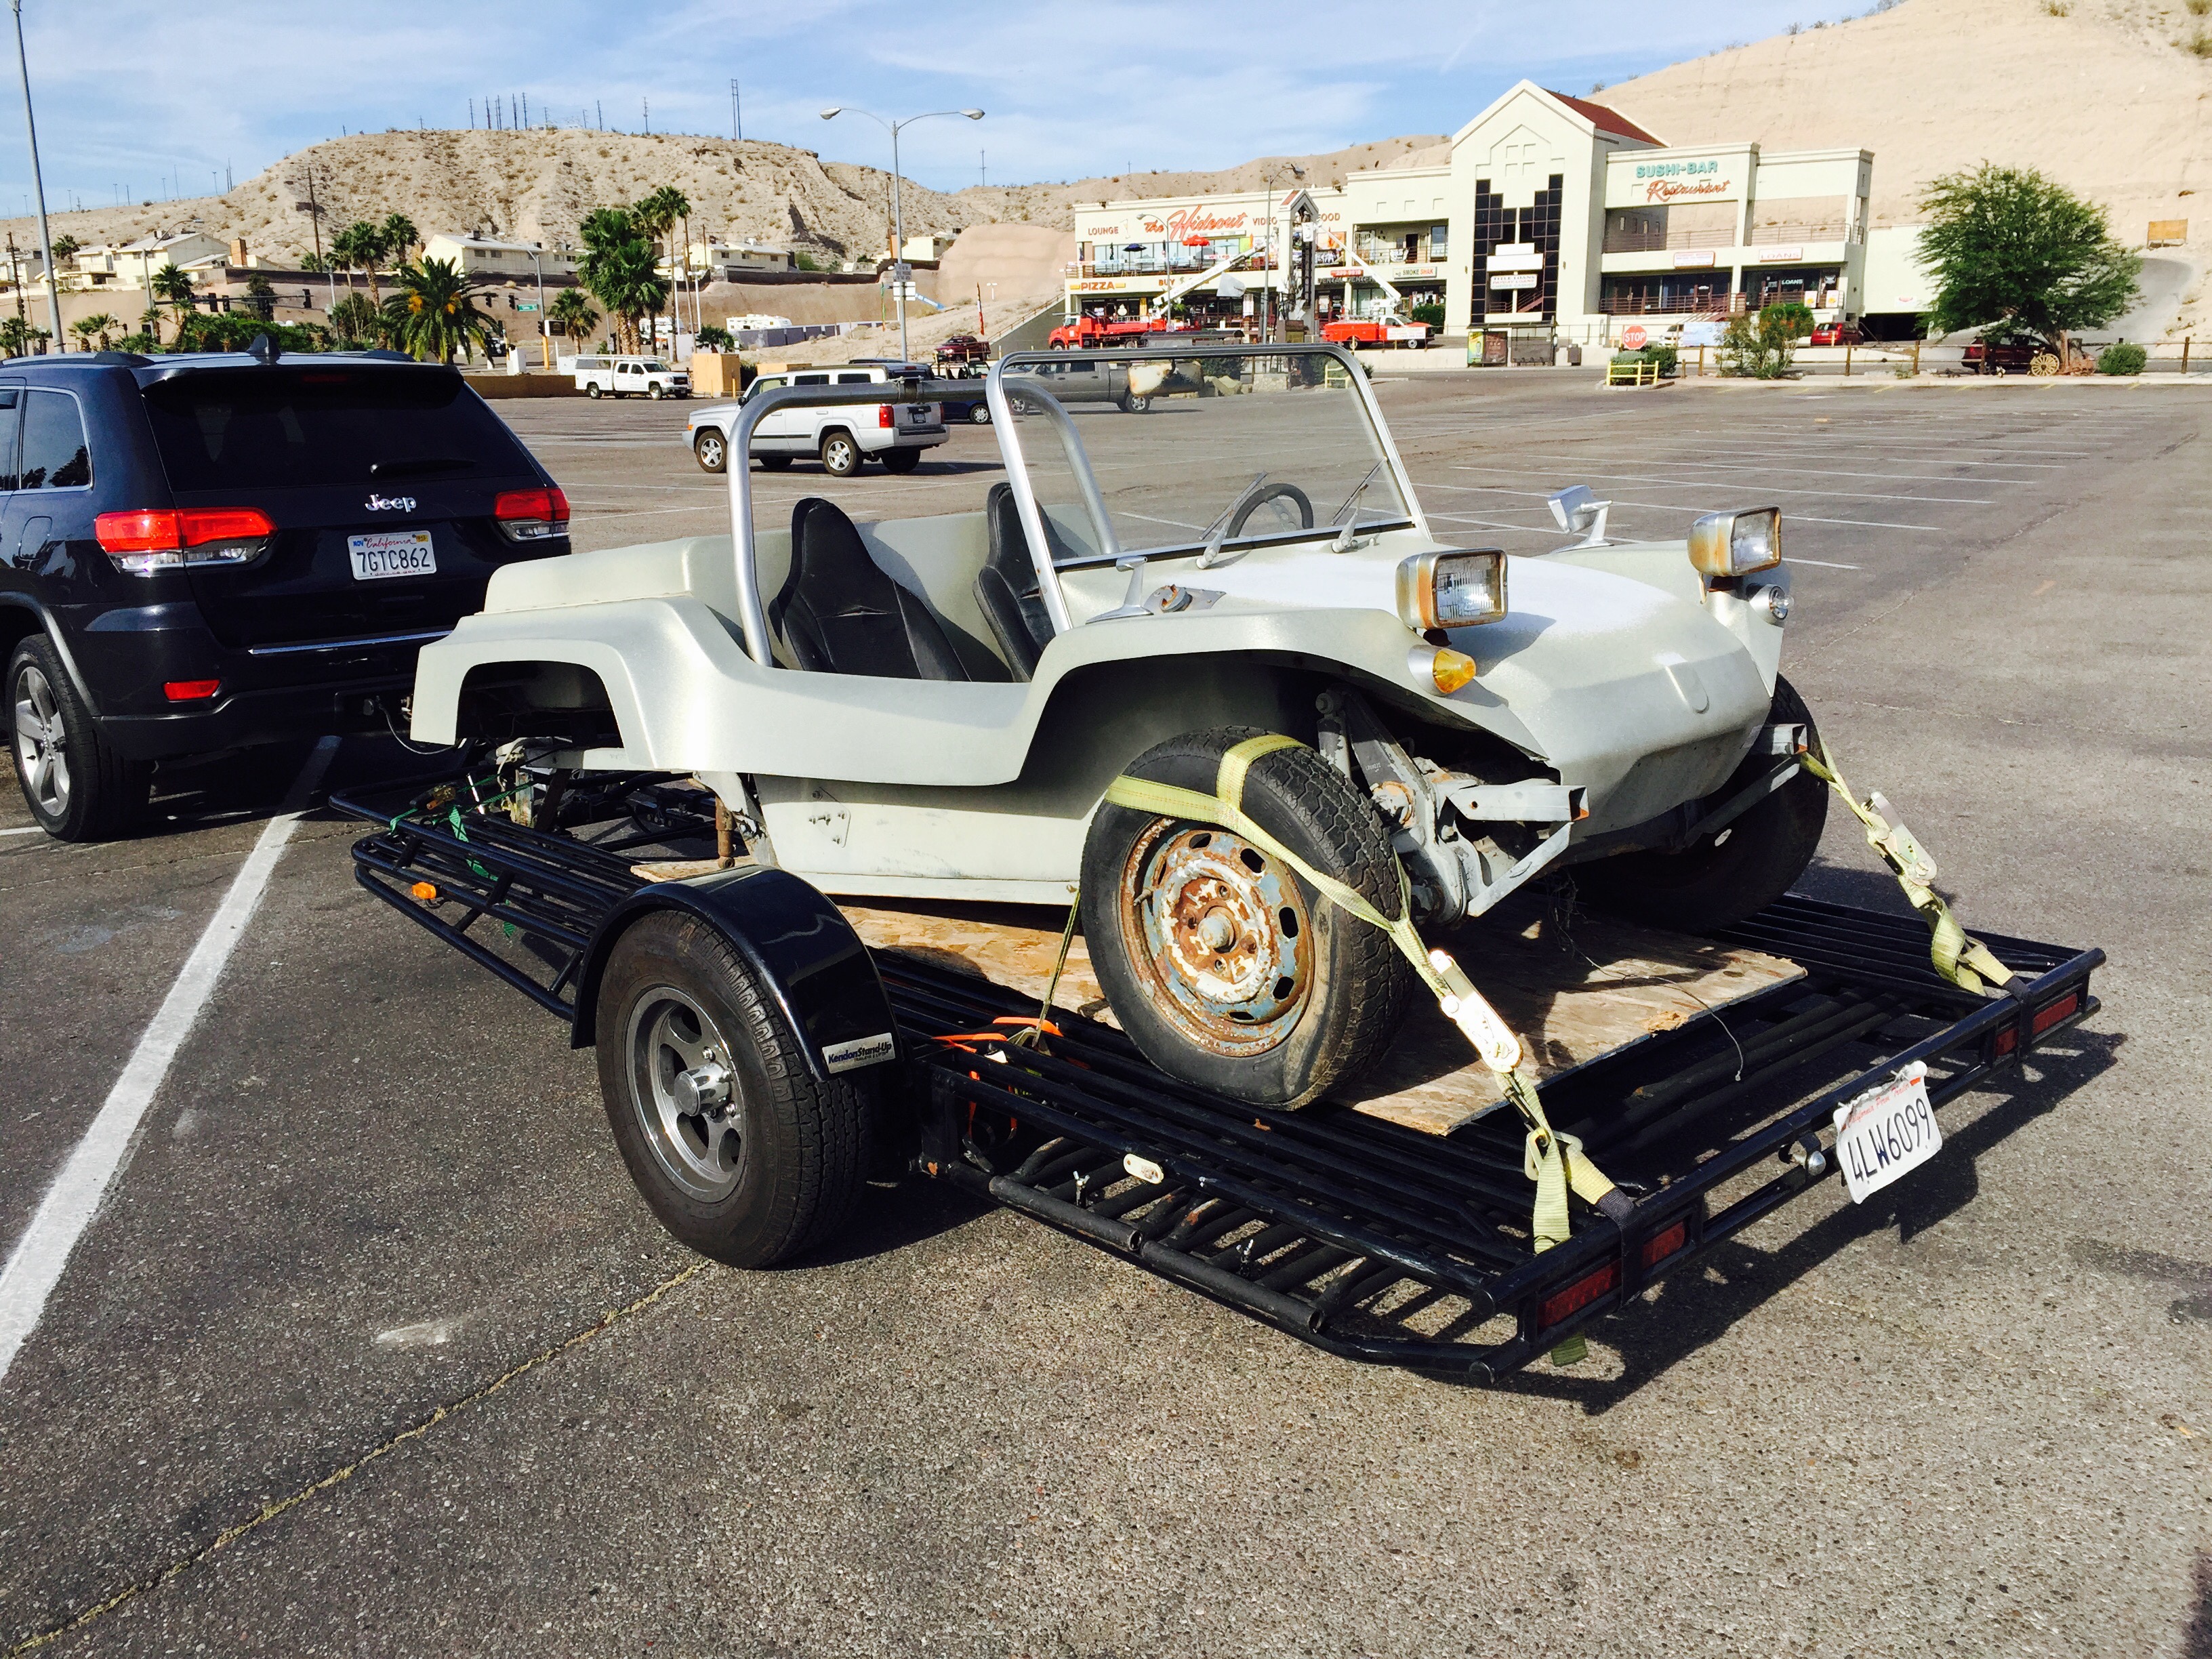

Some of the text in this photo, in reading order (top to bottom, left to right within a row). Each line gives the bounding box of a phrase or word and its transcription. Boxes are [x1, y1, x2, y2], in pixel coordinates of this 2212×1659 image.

[1636, 160, 1718, 178] SUSHI-BAR
[1646, 179, 1731, 203] Restaurant
[1088, 226, 1119, 236] LOUNGE
[1167, 204, 1248, 242] Hideout
[1080, 281, 1115, 291] PIZZA
[1624, 331, 1647, 343] STOP
[365, 493, 417, 513] Jeep
[366, 537, 417, 550] California
[356, 547, 430, 573] 7GTC862
[1847, 1098, 1931, 1182] 4LW6099
